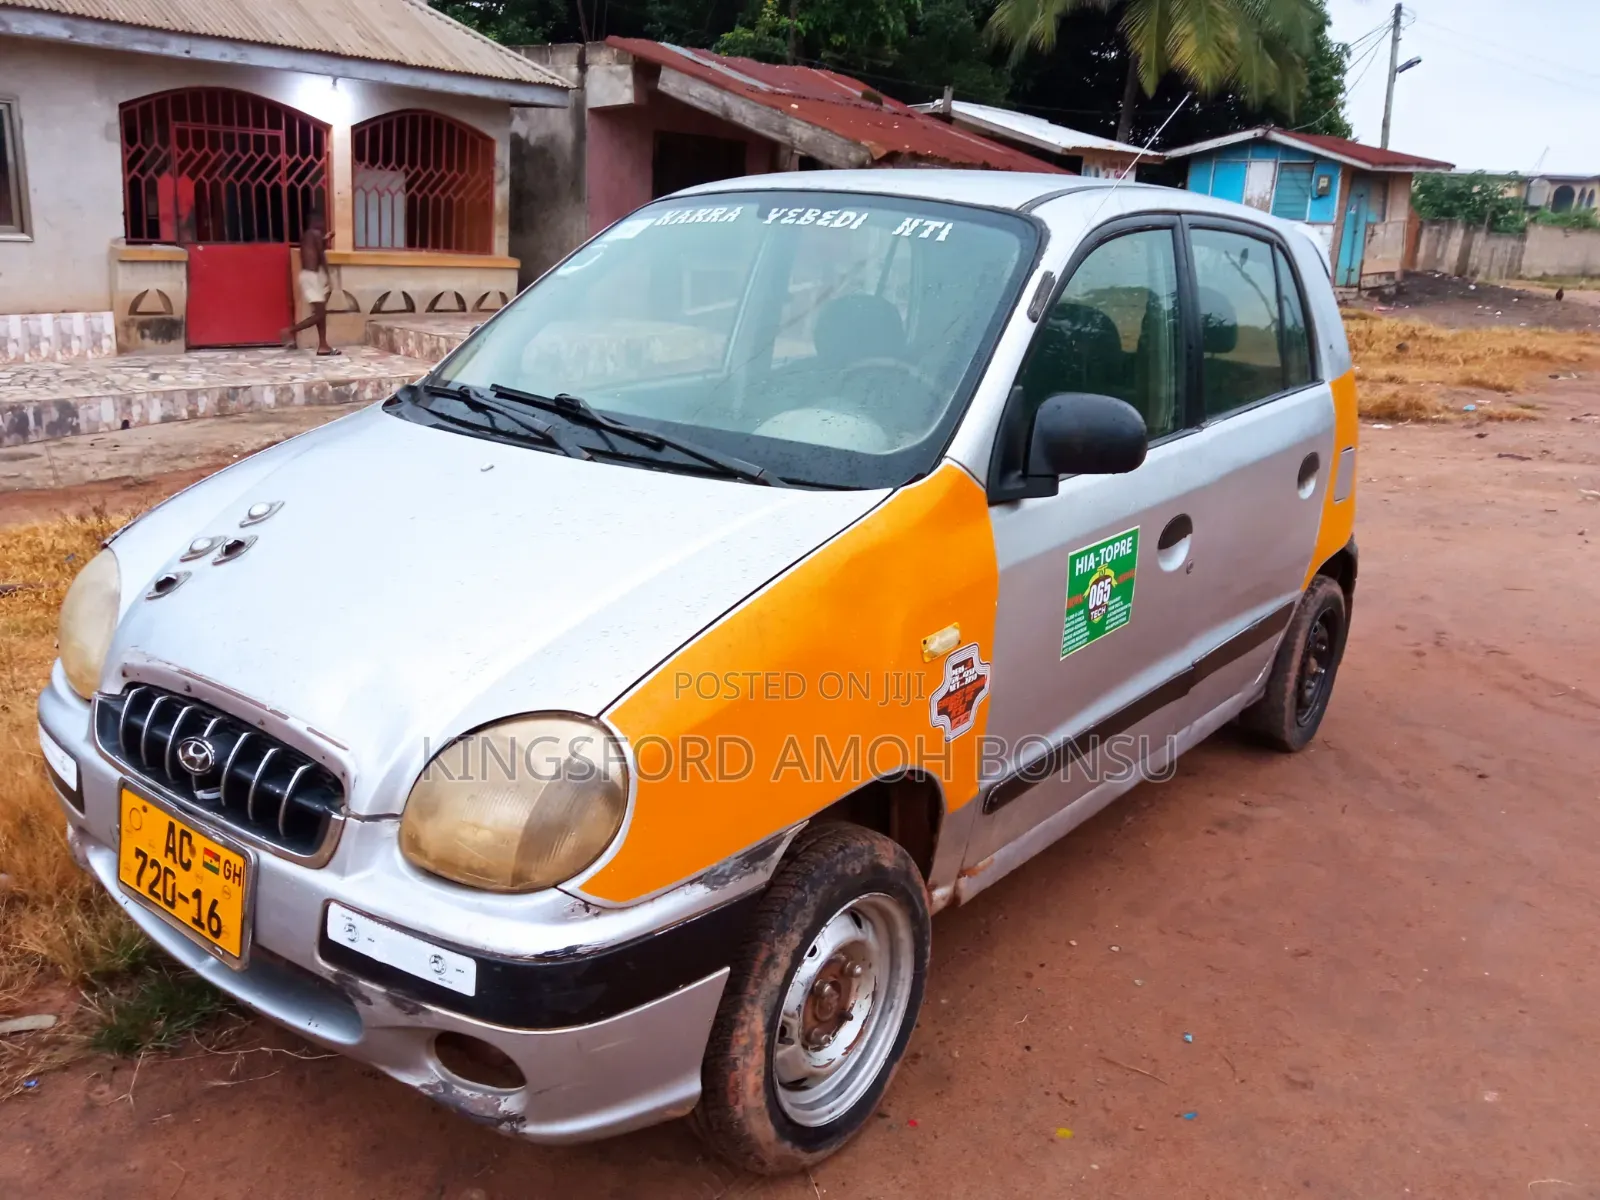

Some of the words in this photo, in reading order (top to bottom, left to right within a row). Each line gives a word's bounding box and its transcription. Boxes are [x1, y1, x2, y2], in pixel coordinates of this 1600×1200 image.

[892, 217, 954, 242] NTI
[1075, 536, 1133, 577] HIA-TOPRE
[1088, 577, 1112, 610] 065
[1090, 605, 1107, 621] TECH
[164, 820, 193, 872] AC
[223, 859, 243, 888] GH
[134, 846, 222, 939] 720-16
